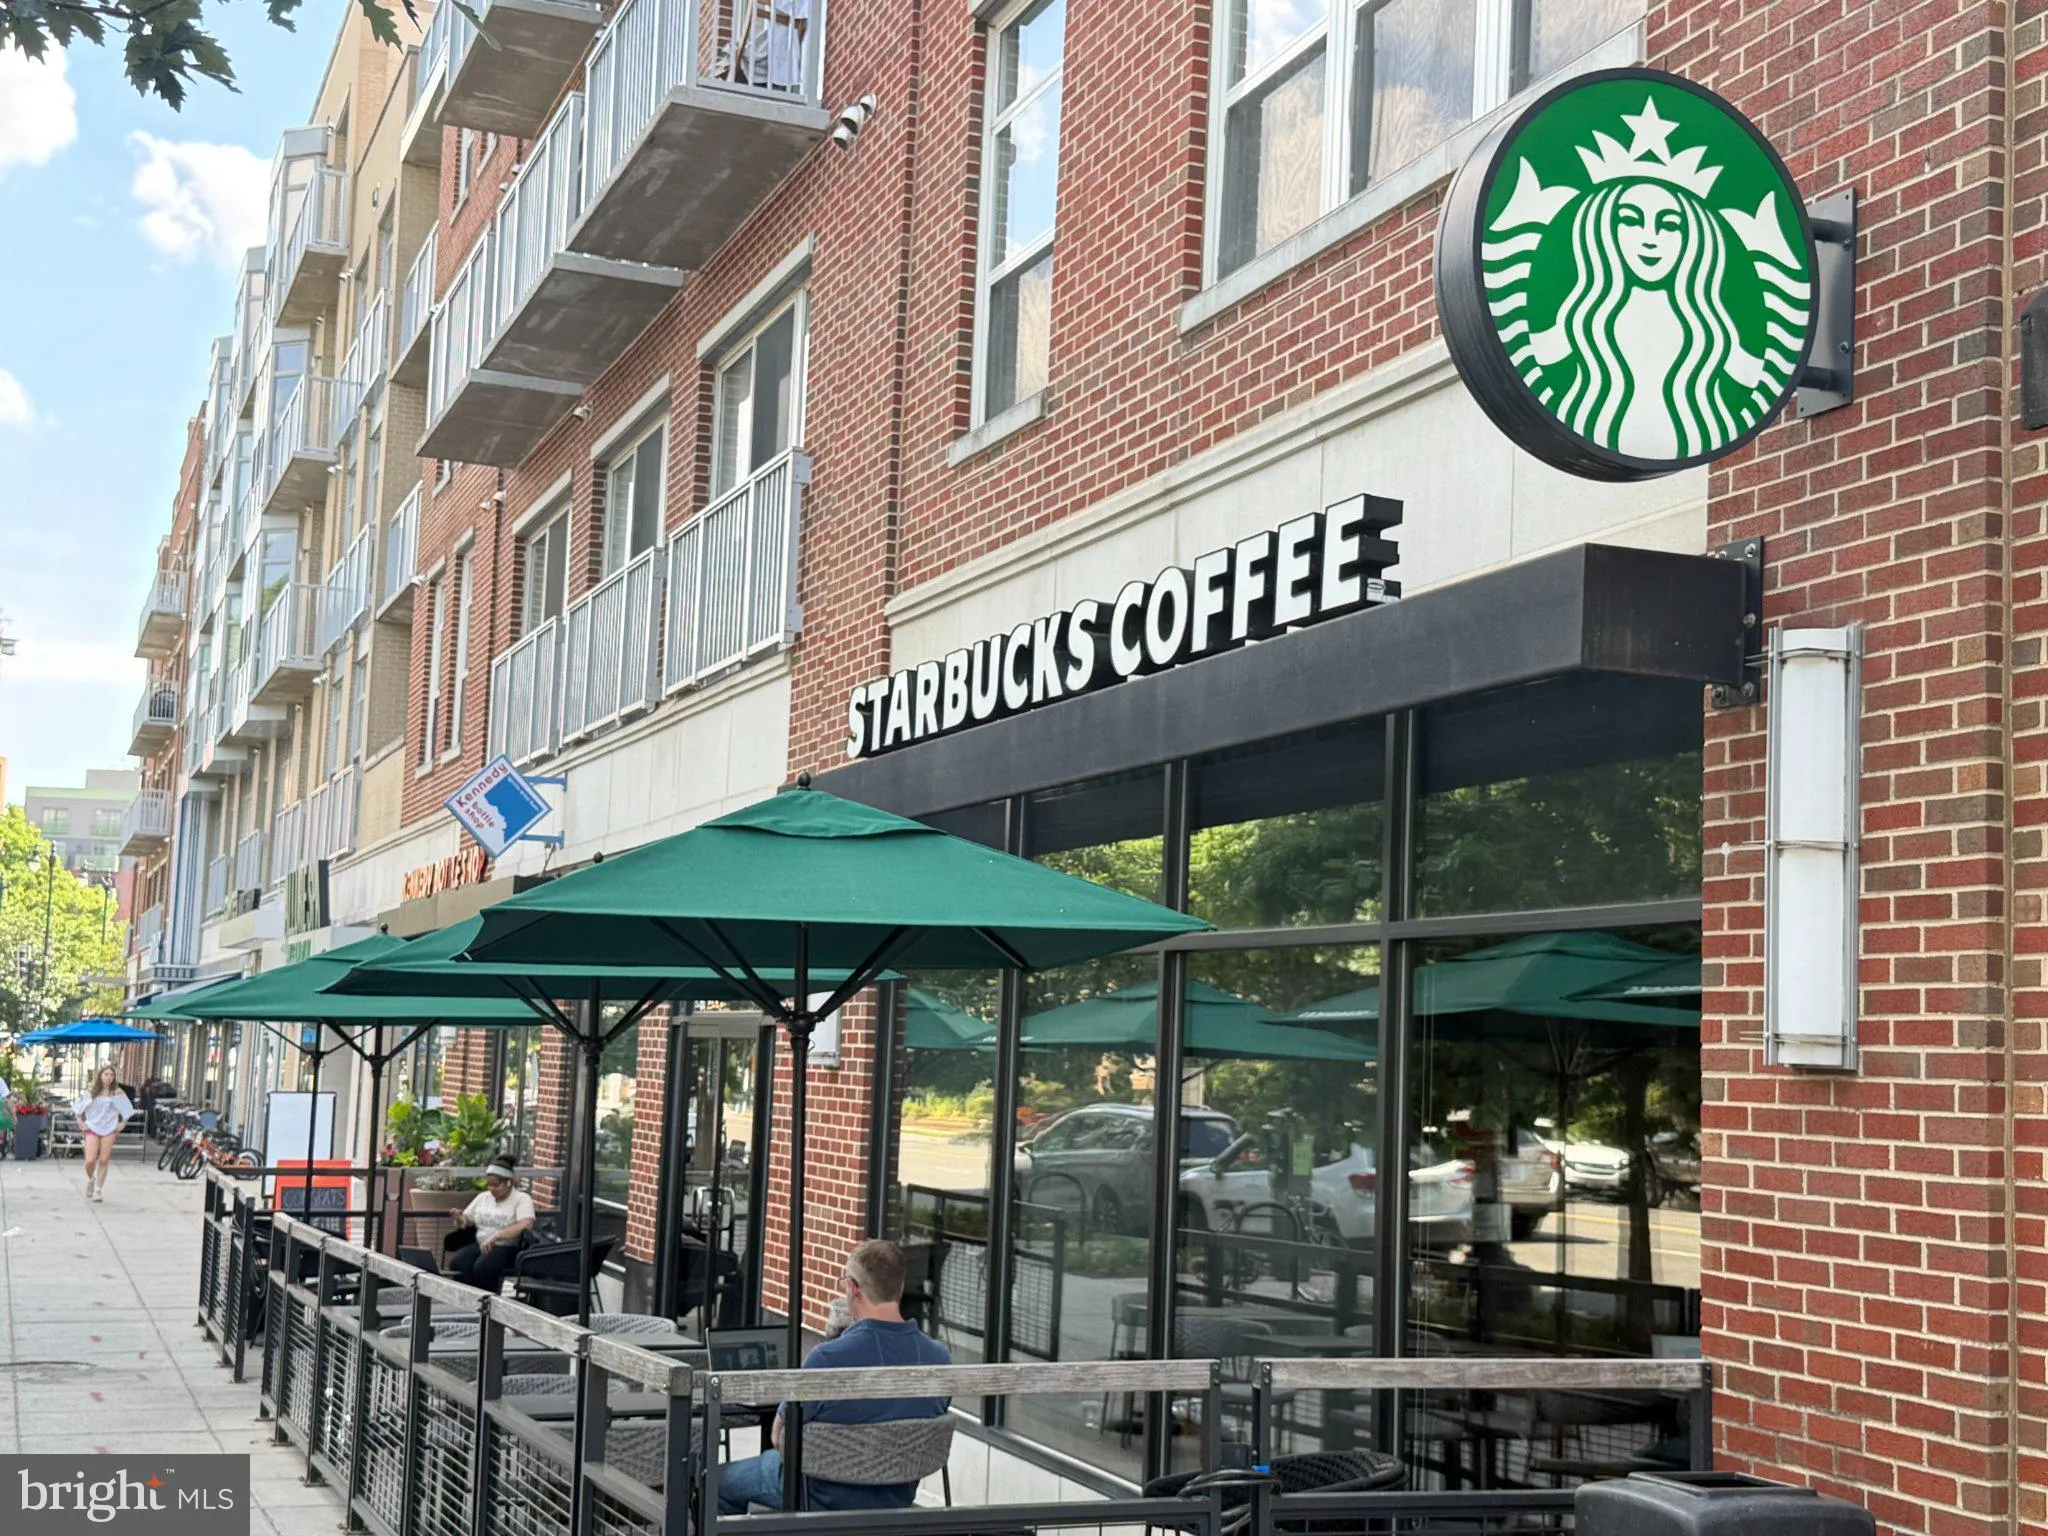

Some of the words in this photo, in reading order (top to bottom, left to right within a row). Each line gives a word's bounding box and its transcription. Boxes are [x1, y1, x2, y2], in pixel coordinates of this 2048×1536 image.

[846, 600, 1100, 760] STARBUCKS
[1110, 494, 1368, 678] COFFEE
[456, 763, 508, 808] Kennedy
[465, 808, 485, 829] shop
[472, 801, 495, 828] bottle
